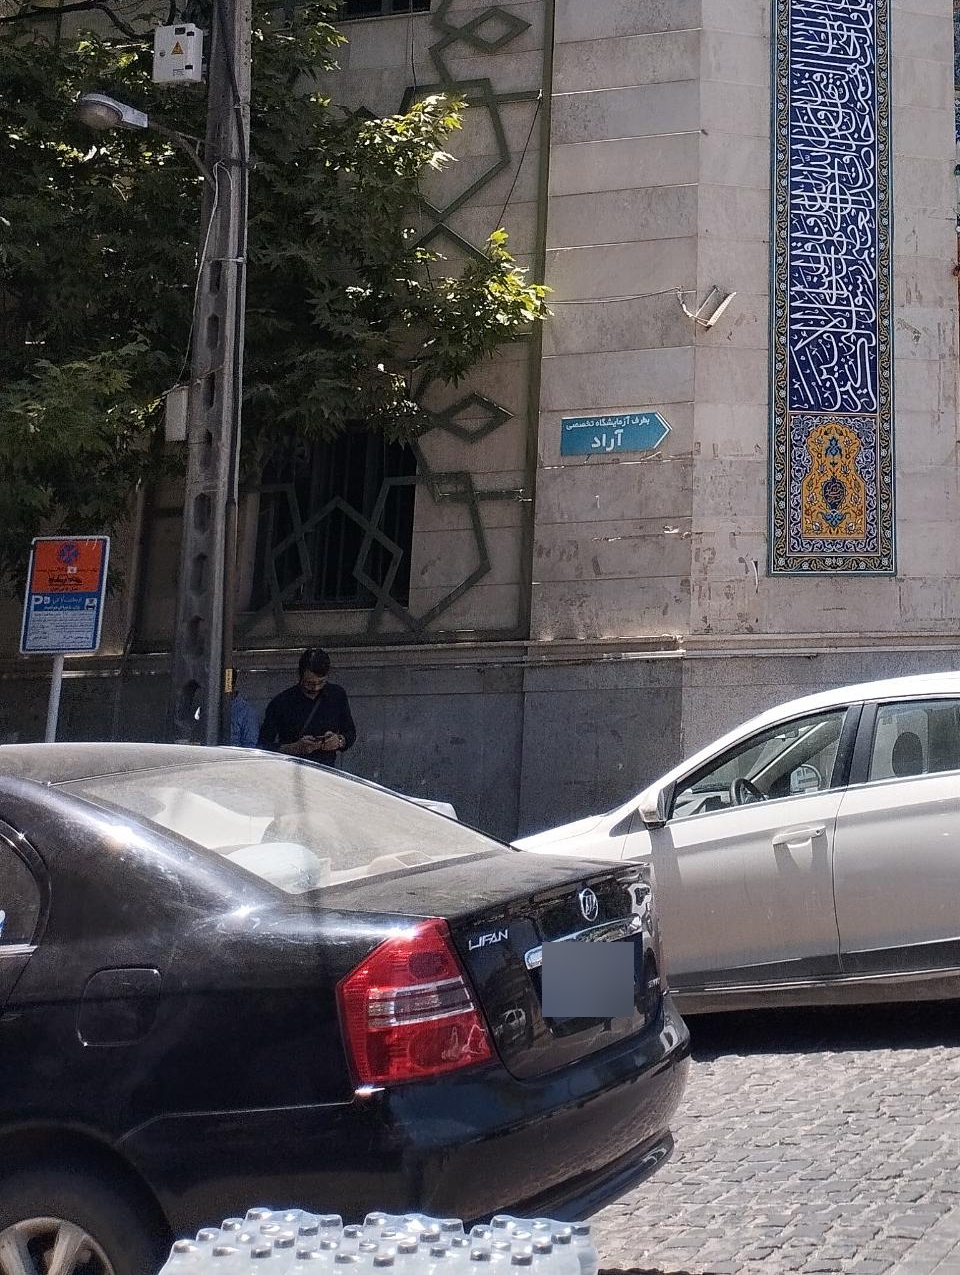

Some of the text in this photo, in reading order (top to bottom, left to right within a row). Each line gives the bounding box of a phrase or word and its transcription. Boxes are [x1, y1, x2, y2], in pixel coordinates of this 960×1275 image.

[566, 421, 594, 431] تخصصی
[595, 416, 630, 427] آزمایشگاه
[591, 429, 623, 451] آراد
[468, 929, 508, 951] LIFAN
